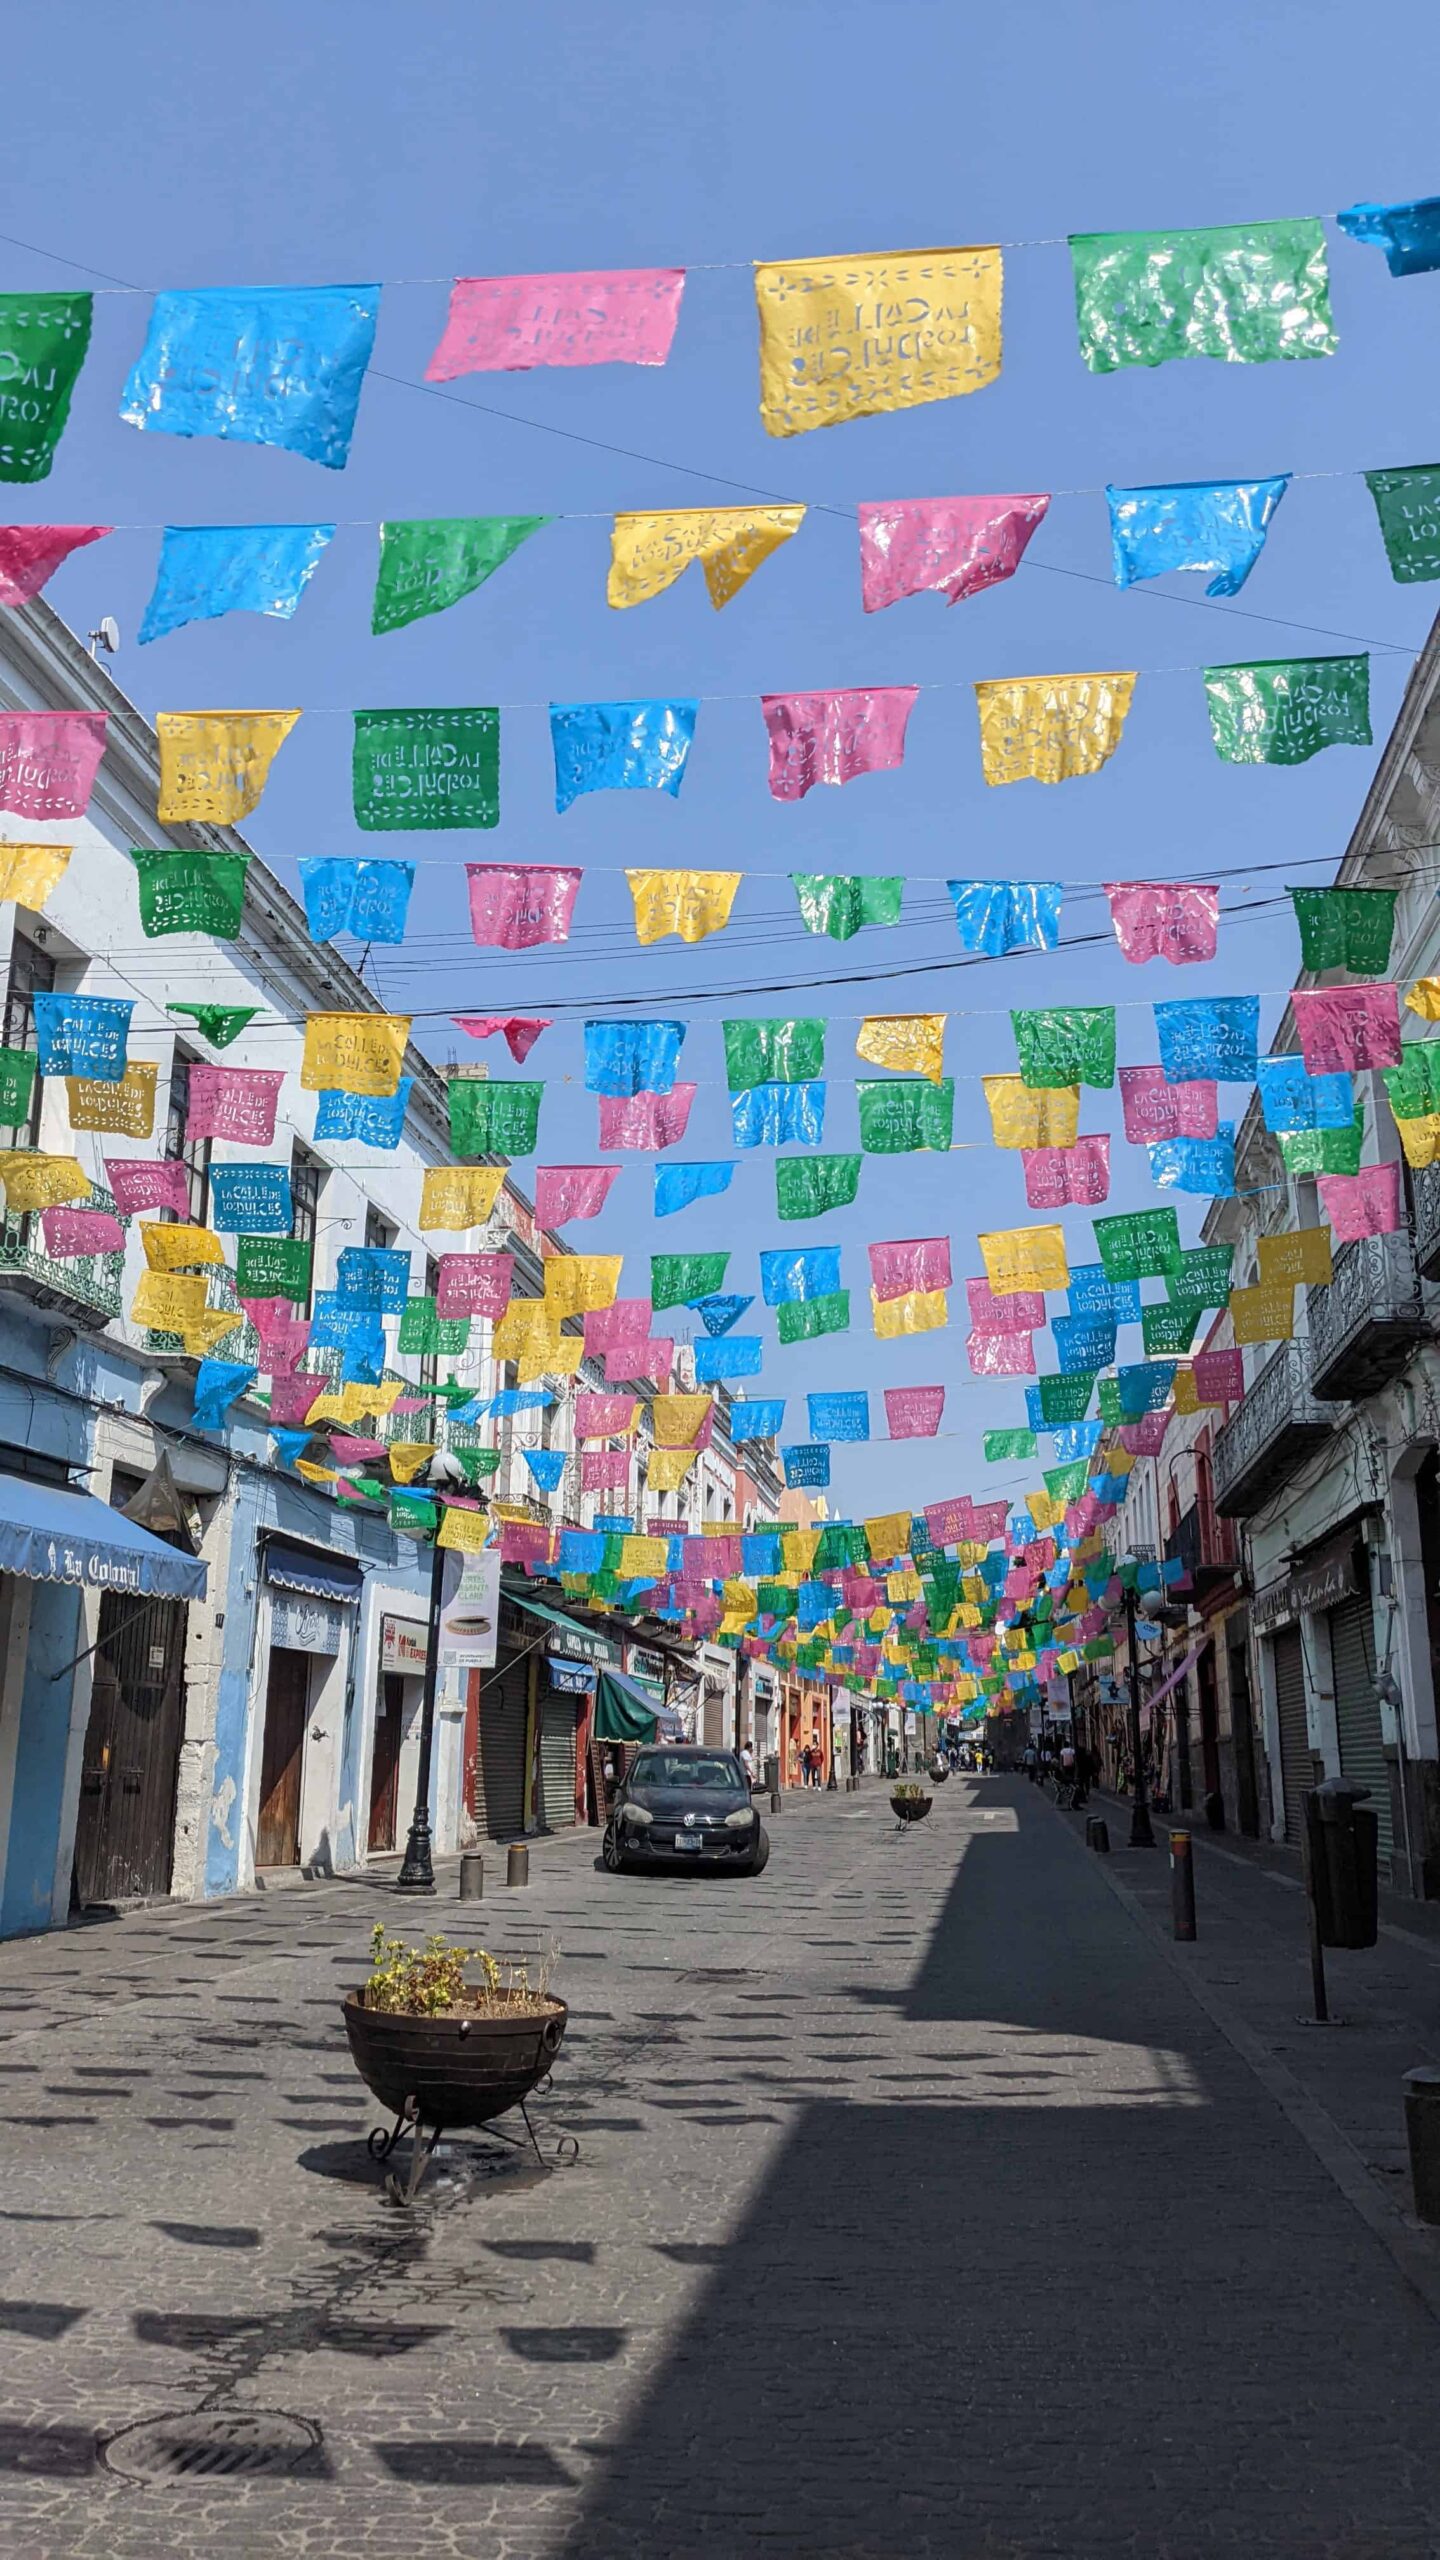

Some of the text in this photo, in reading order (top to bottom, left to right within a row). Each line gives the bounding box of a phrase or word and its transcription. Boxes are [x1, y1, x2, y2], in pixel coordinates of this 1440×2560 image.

[222, 1185, 281, 1201] LA CALLE DE
[236, 1201, 282, 1216] DULCES
[1174, 1277, 1186, 1286] LA
[1185, 1267, 1219, 1284] CALLE
[1076, 1284, 1133, 1298] LA CALLE DE
[1177, 1285, 1193, 1297] LOS
[1092, 1295, 1134, 1316] DULCES
[1150, 1321, 1162, 1331] LA
[64, 1549, 140, 1587] La Colonial
